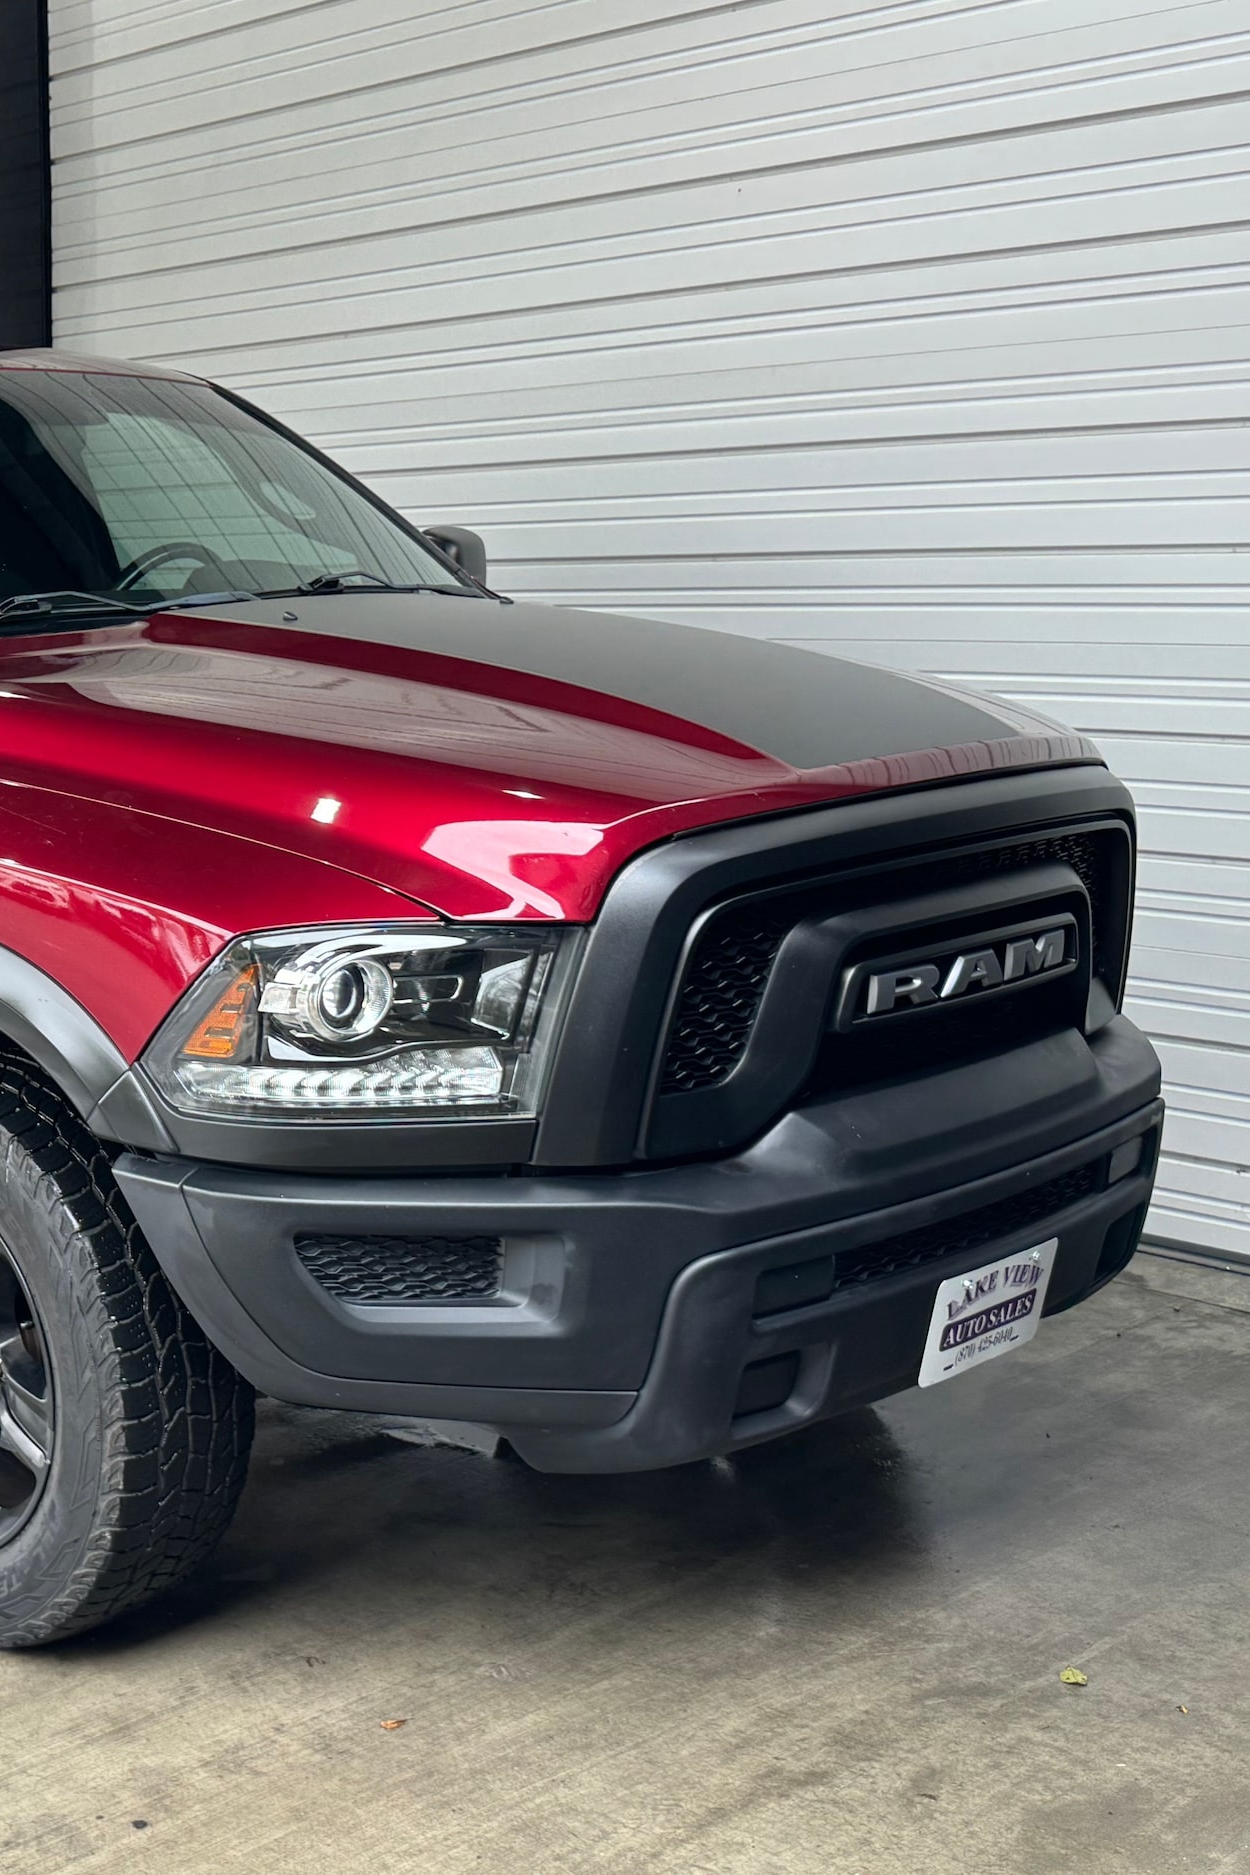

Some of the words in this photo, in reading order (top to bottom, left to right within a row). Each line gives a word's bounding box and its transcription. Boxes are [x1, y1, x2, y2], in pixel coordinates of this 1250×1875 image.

[866, 928, 1065, 1014] RAM
[947, 1270, 999, 1320] LAKE
[1003, 1265, 1044, 1289] VIEW
[943, 1313, 986, 1347] AUTO
[987, 1294, 1033, 1329] SALES
